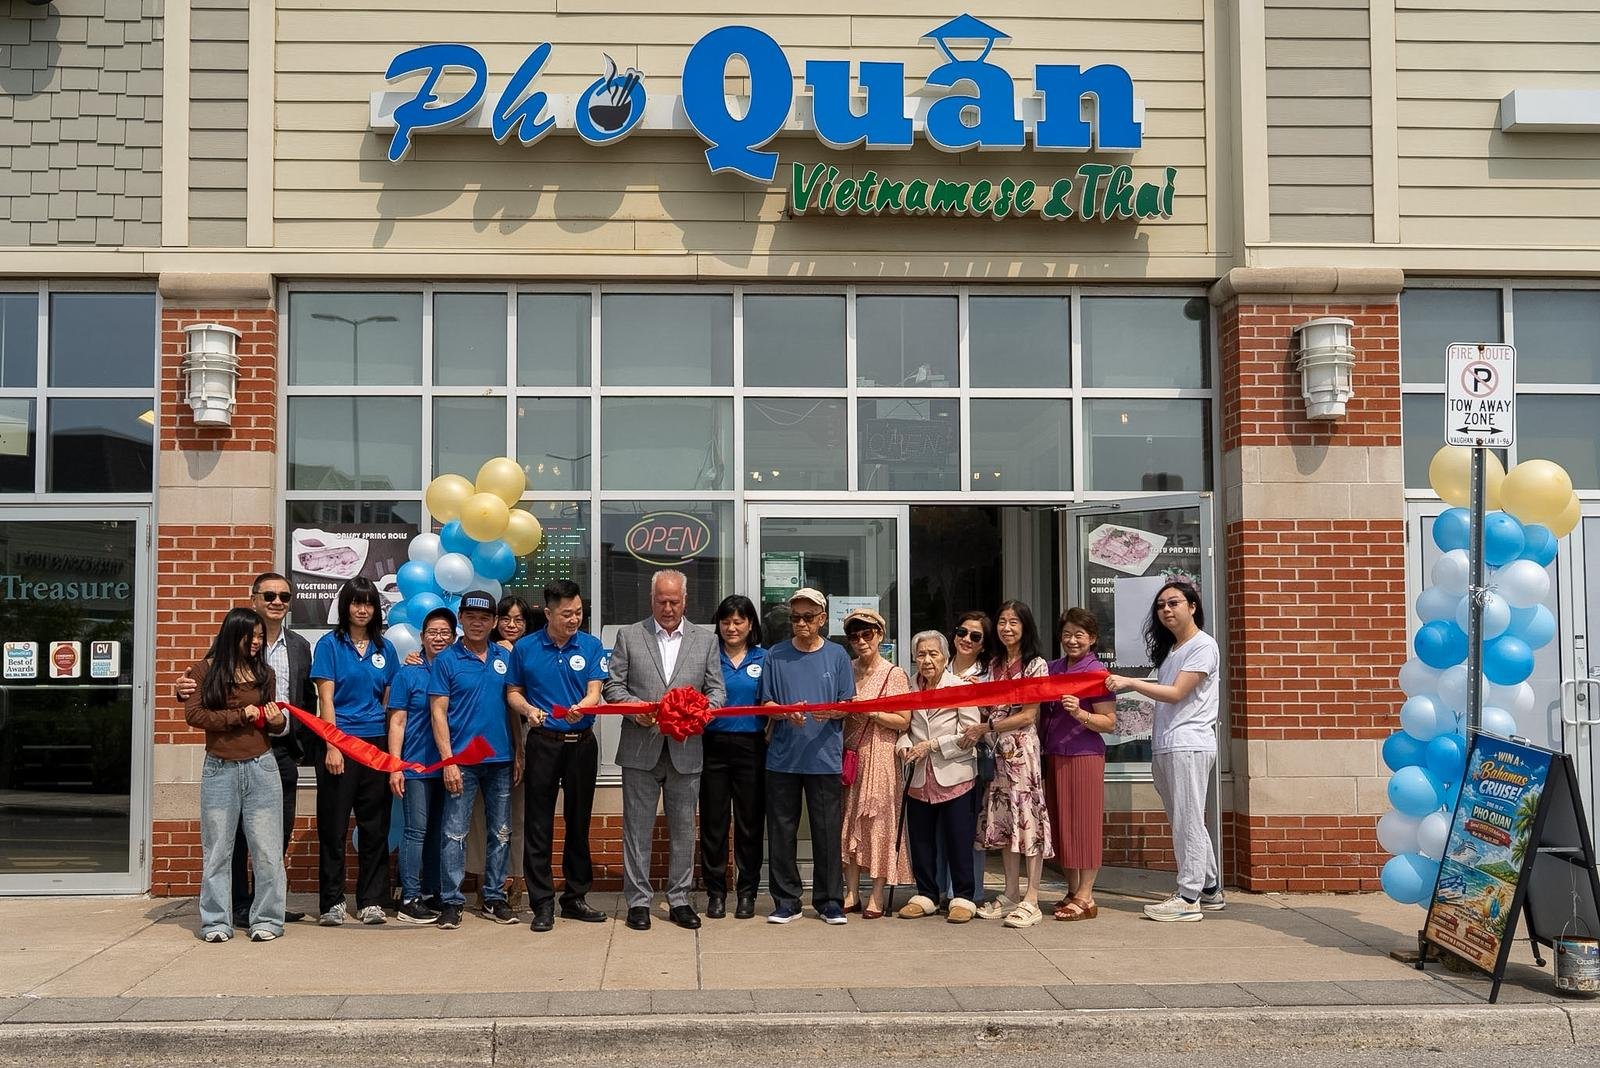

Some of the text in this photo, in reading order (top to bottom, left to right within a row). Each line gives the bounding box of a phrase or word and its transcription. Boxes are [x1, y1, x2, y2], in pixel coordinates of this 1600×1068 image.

[791, 162, 1177, 222] Vietnamese & Thai
[1450, 347, 1511, 360] FIRE ROUTE
[1450, 399, 1512, 413] TOW AWAY
[1464, 413, 1495, 425] ZONE
[1450, 436, 1474, 445] VAUGHAN
[362, 532, 387, 540] SPRING
[388, 532, 408, 540] ROLLS
[629, 526, 702, 552] OPEN
[1168, 546, 1184, 554] PAD
[0, 574, 130, 600] Treasure
[1090, 586, 1115, 594] CHICK
[296, 592, 339, 600] FRESH ROLLS
[96, 643, 109, 653] CV
[8, 658, 33, 666] Best of
[6, 665, 34, 673] Awards
[1497, 751, 1520, 767] WIN A
[1480, 761, 1528, 786] Bahamas
[1479, 780, 1523, 801] CRUISE!
[1473, 806, 1512, 830] PHO QUAN
